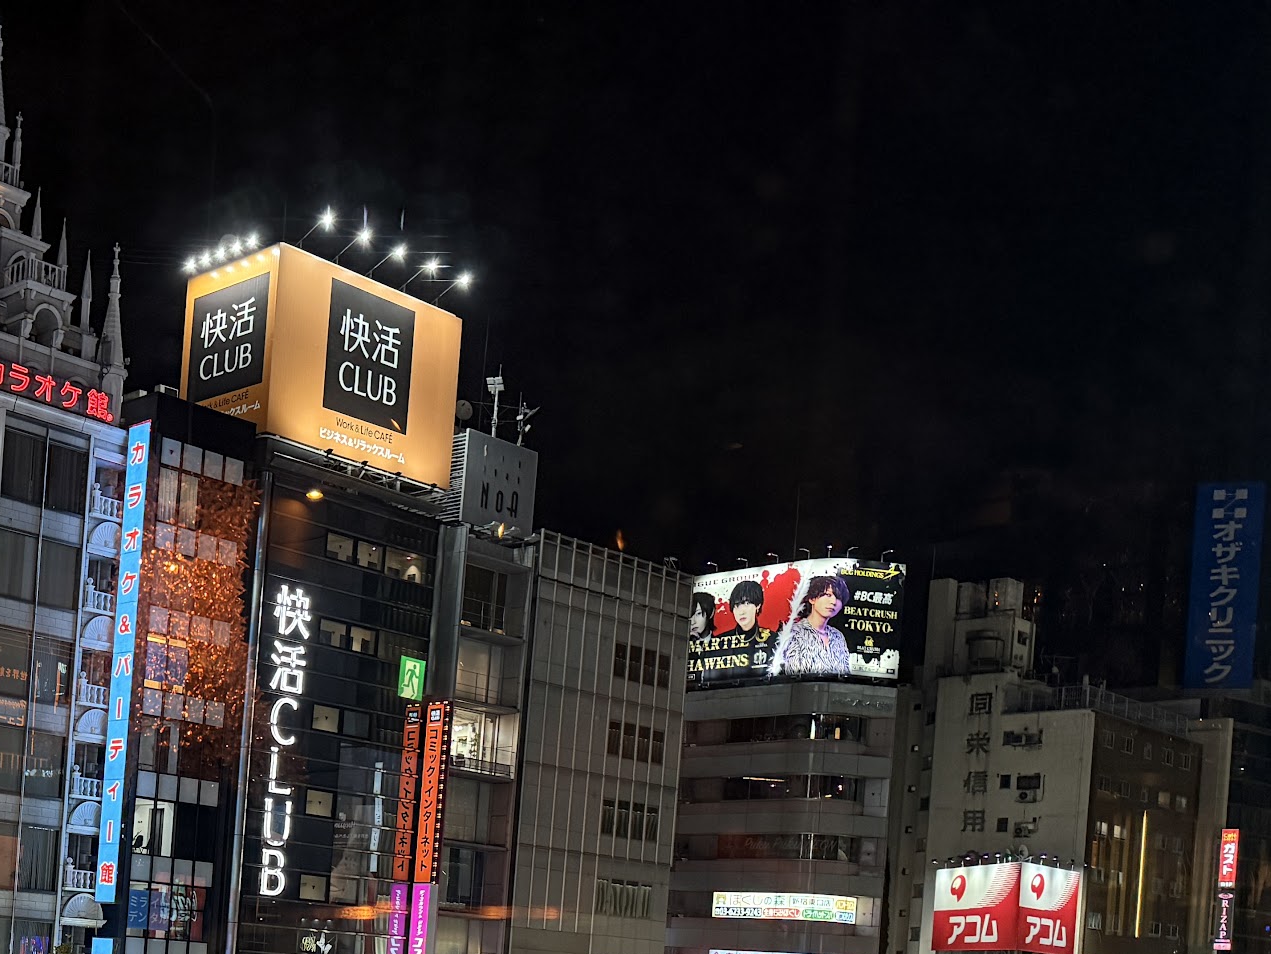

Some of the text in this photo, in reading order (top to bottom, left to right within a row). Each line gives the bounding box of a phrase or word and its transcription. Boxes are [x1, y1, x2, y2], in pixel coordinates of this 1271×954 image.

[200, 296, 257, 349] 快活
[339, 308, 402, 370] 快活
[199, 343, 252, 381] CLUB
[338, 361, 397, 407] CLUB
[1204, 520, 1243, 683] オザキクリニック
[259, 584, 312, 896] 快活CLUB
[419, 728, 439, 872] コミック・インターネット
[1222, 842, 1236, 876] ガスト
[729, 894, 786, 907] ほぐしの森
[1219, 899, 1229, 939] RIZAP
